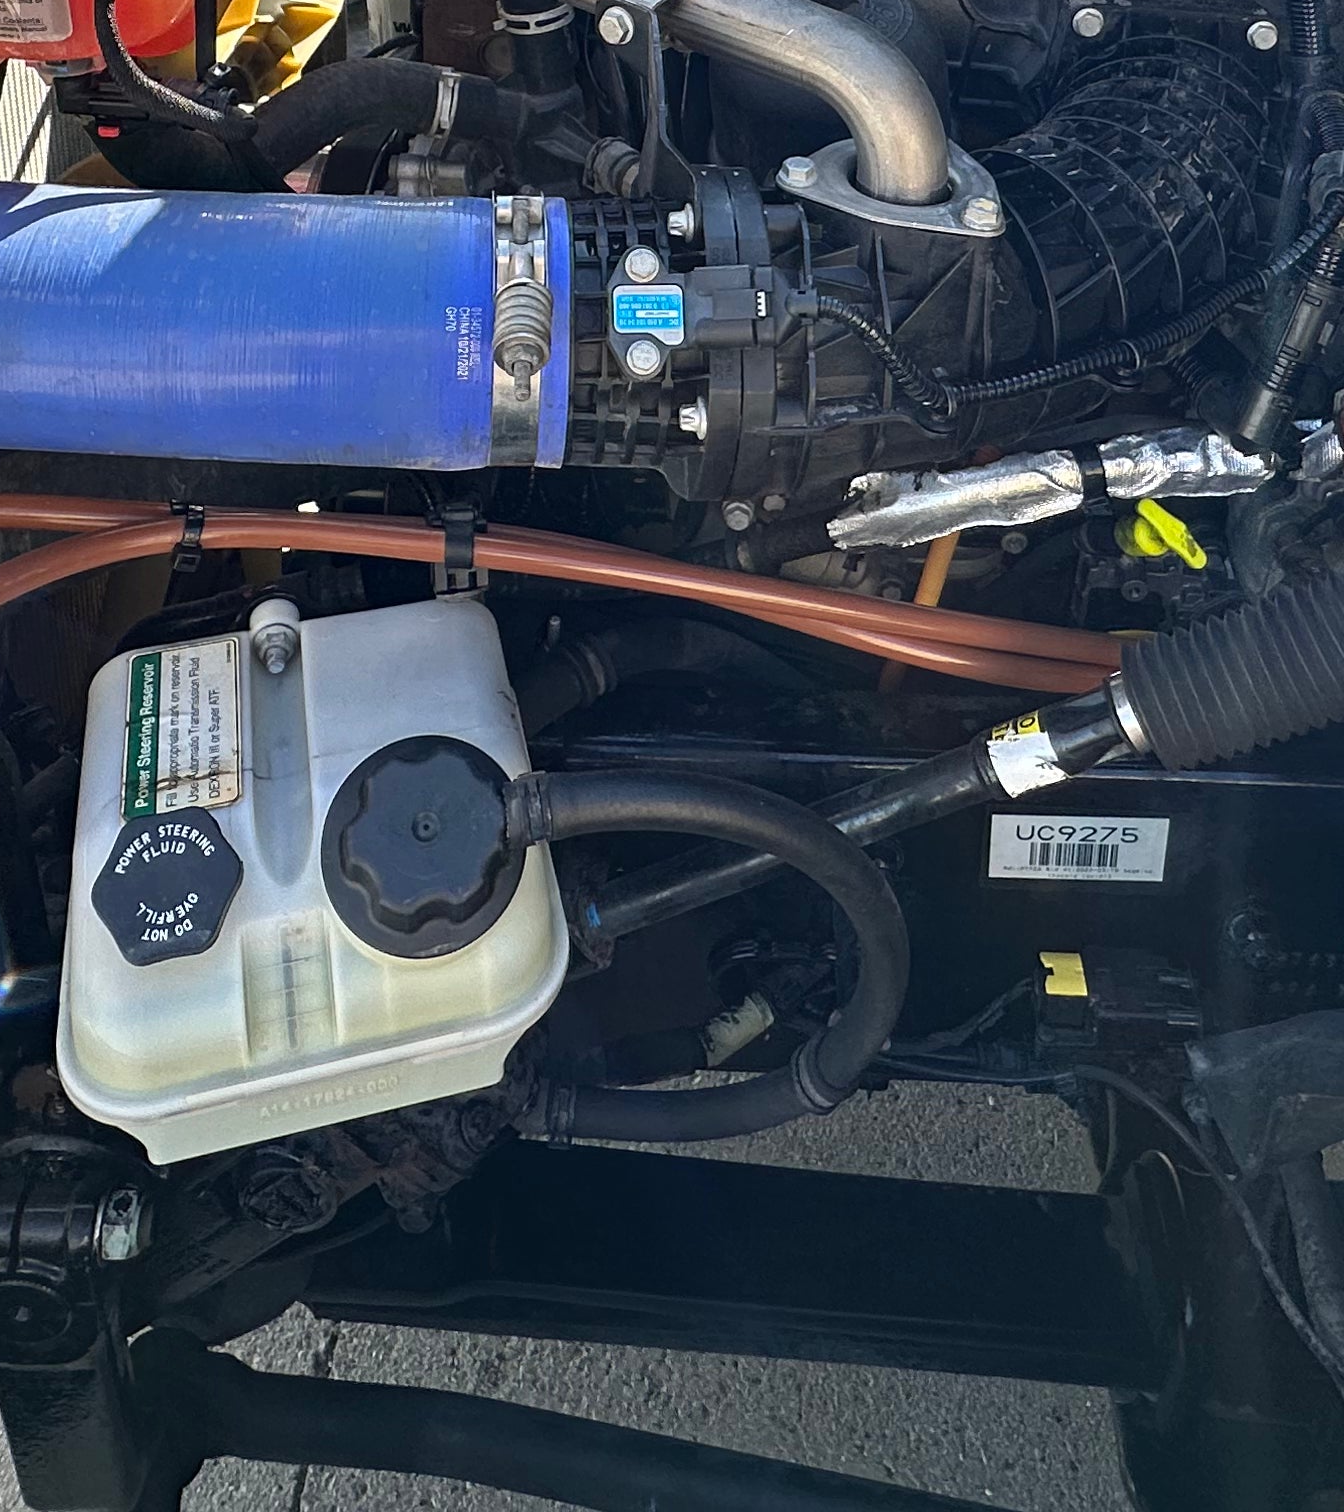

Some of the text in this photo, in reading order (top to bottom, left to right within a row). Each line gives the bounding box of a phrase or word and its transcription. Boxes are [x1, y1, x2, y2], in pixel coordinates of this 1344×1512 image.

[445, 306, 457, 332] GH70
[458, 307, 470, 334] CHINA
[170, 691, 179, 702] on
[188, 657, 200, 802] Use Automatic Transmission Fluid
[209, 708, 222, 733] Super
[135, 662, 155, 809] Power Steering Reservoir
[1016, 825, 1139, 843] UC9275
[115, 824, 215, 874] POWER STEERING
[142, 840, 185, 863] FLUID
[136, 893, 198, 925] OVERFILL
[141, 918, 193, 942] DO NOT
